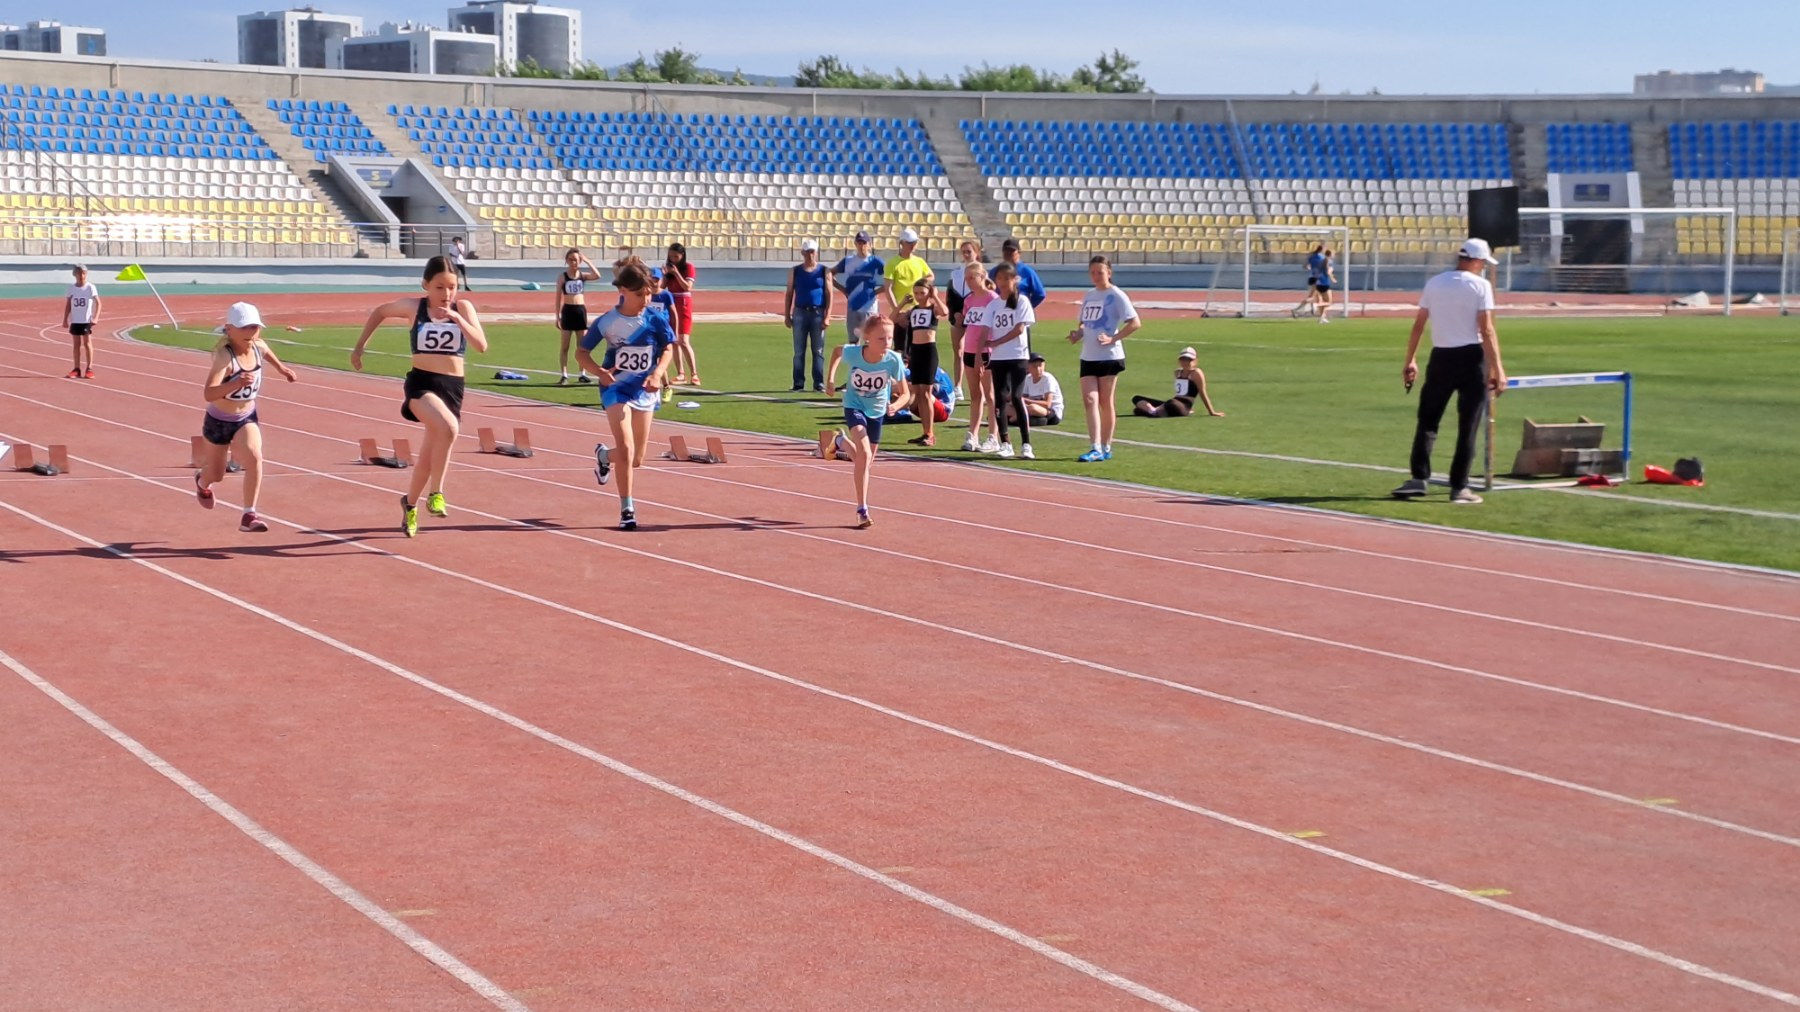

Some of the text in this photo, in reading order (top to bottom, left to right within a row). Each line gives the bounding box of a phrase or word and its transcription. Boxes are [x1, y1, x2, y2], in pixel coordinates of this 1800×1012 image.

[73, 298, 86, 307] 38
[912, 314, 927, 325] 15
[966, 311, 983, 323] 334
[1085, 306, 1102, 319] 377
[995, 313, 1014, 328] 381
[425, 330, 454, 350] 52
[619, 352, 649, 371] 238
[854, 373, 883, 390] 340
